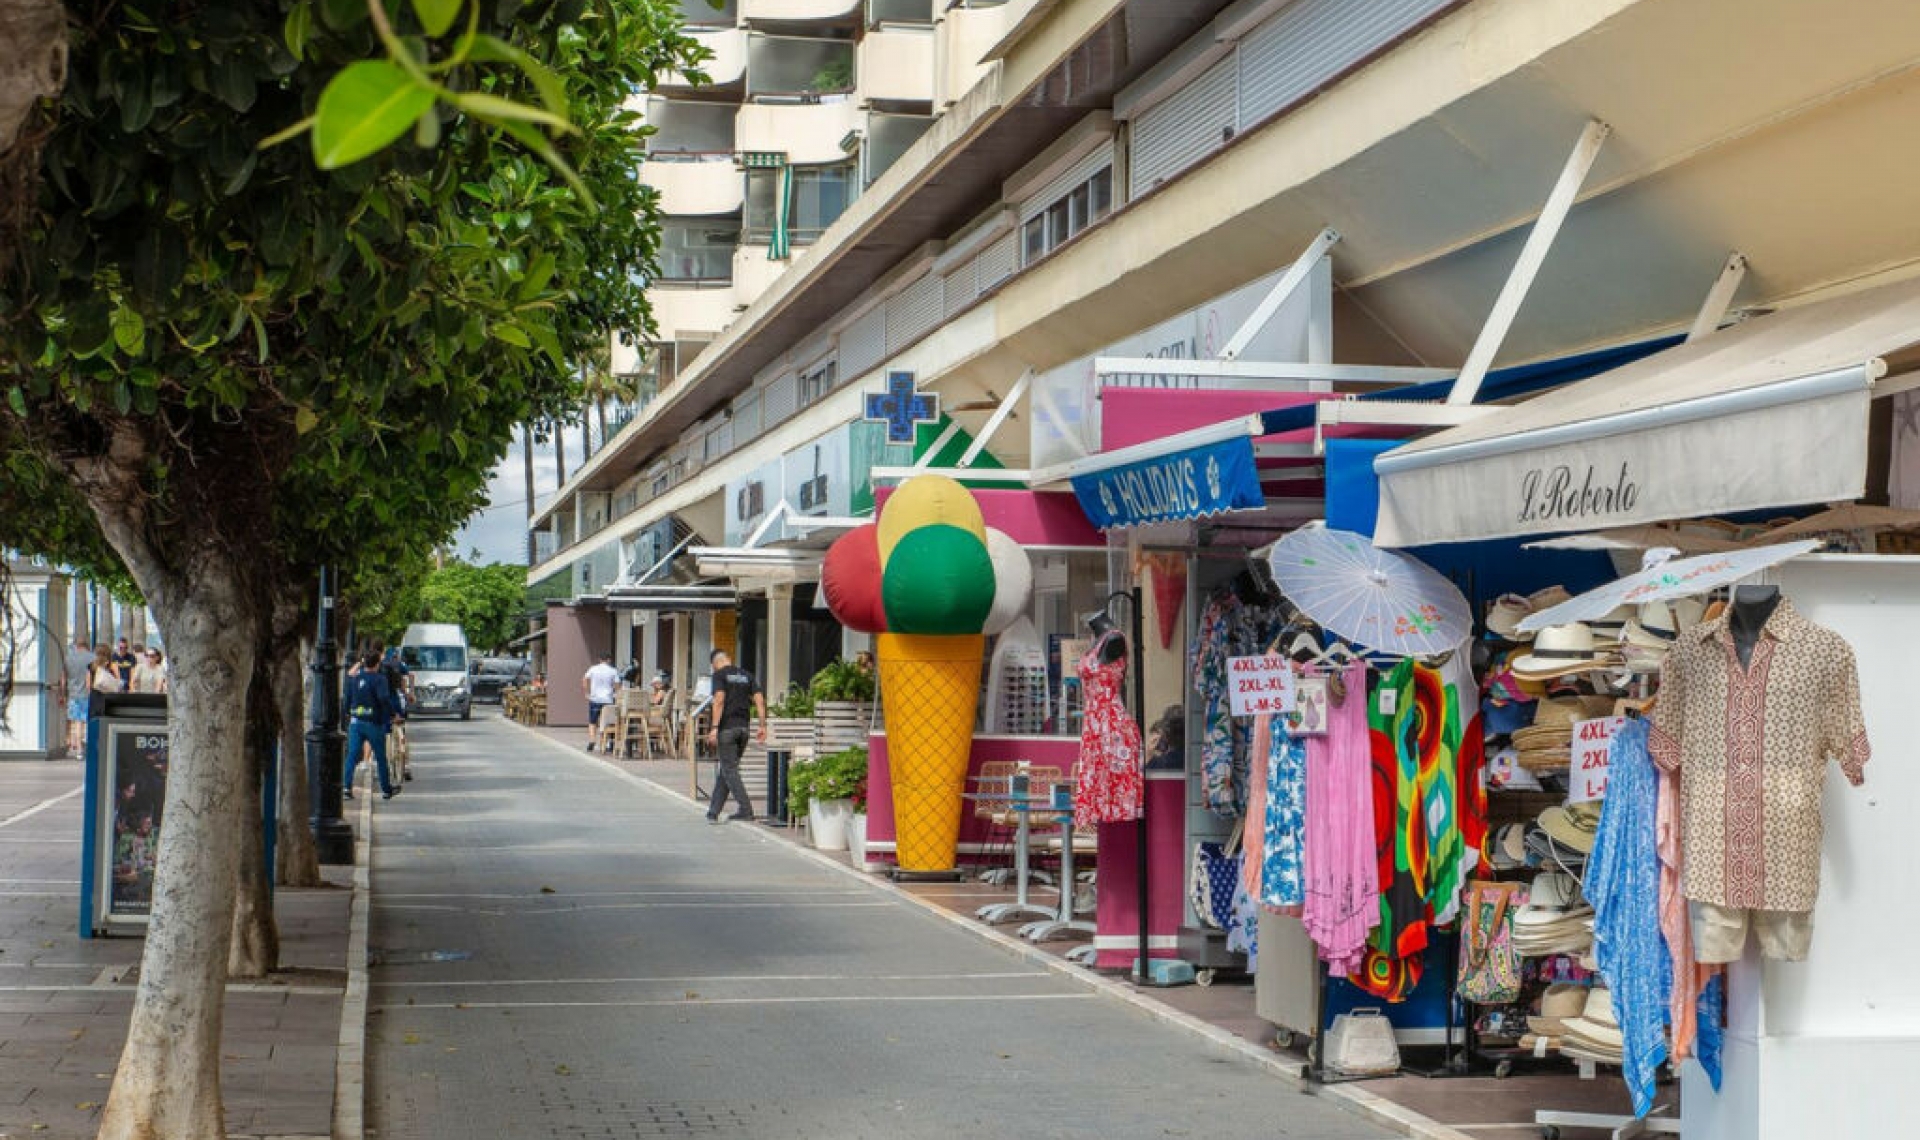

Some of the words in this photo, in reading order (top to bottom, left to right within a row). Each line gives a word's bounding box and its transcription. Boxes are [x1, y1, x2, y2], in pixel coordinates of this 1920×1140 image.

[1114, 457, 1199, 519] HOLIDAYS
[1233, 656, 1286, 671] 4XL-3XL
[1239, 677, 1285, 692] 2XL-XL
[1245, 697, 1282, 713] L-M-S
